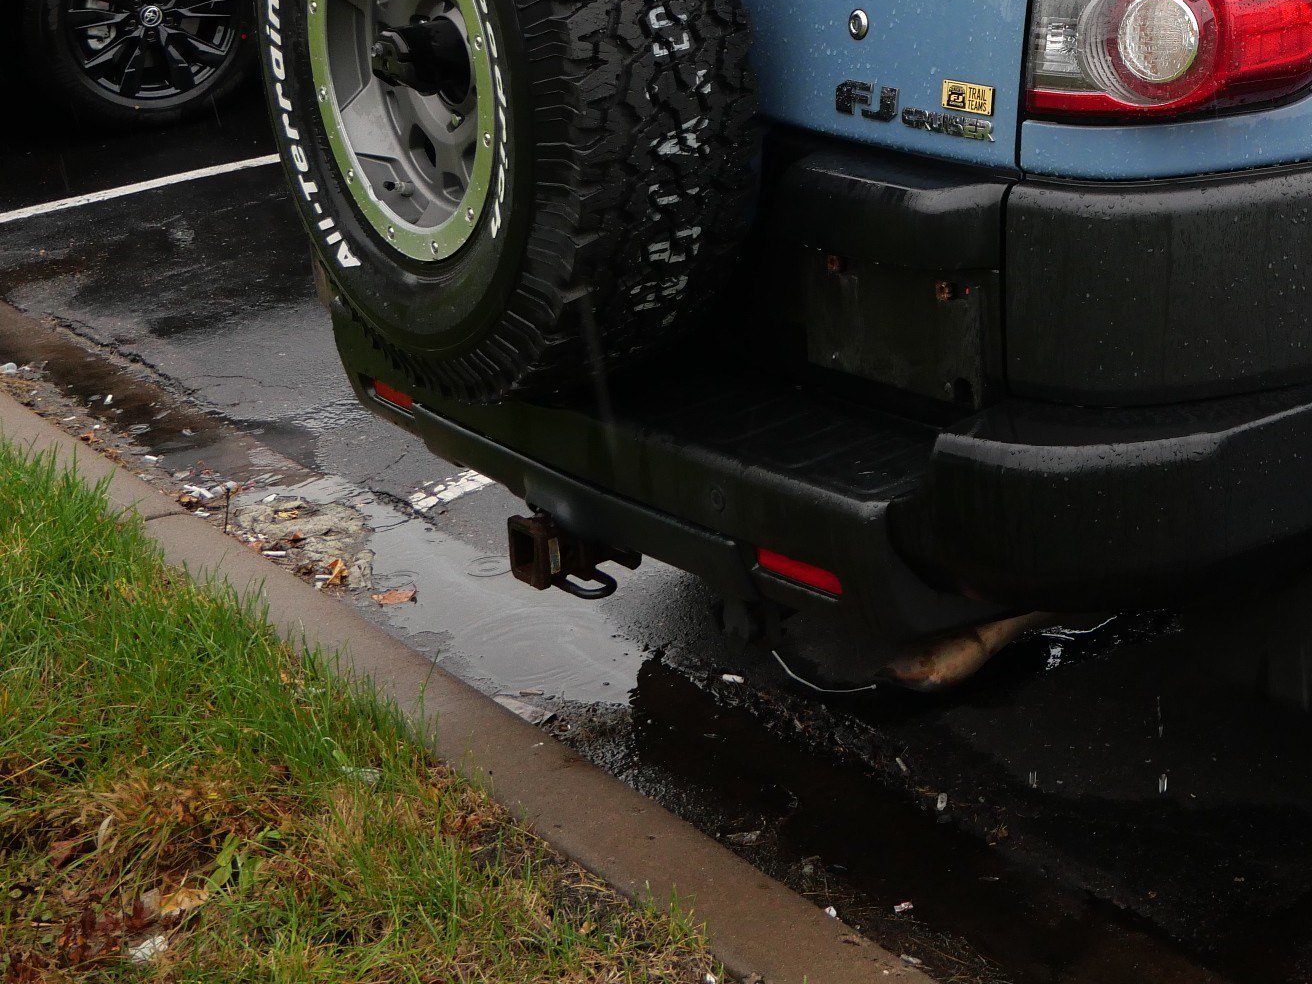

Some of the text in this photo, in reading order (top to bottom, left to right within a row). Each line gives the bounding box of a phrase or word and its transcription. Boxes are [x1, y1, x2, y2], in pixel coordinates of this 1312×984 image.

[835, 80, 899, 121] FJ
[968, 86, 987, 102] TRAIL
[967, 99, 987, 112] TEAMS
